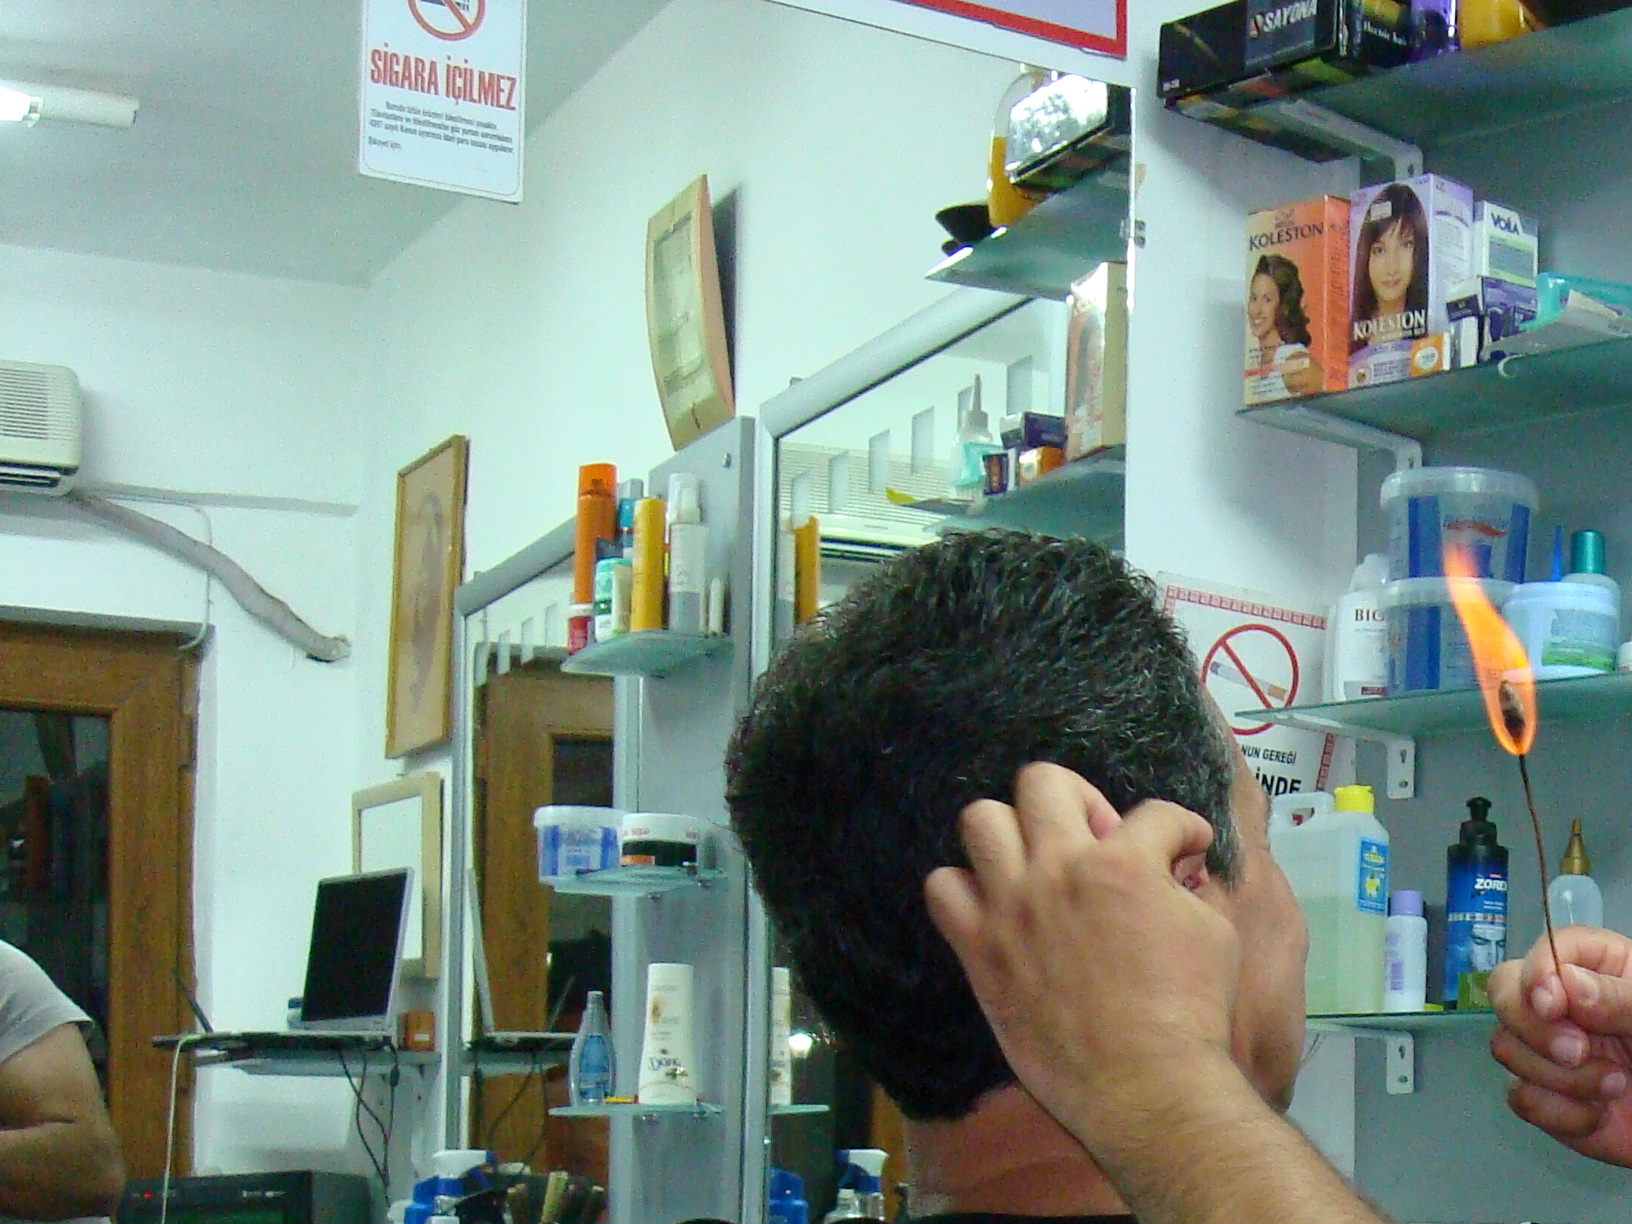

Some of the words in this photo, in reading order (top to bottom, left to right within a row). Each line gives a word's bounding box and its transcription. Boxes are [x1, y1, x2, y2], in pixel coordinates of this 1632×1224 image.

[370, 42, 440, 96] SİGARA
[445, 55, 517, 111] İÇİLMEZ
[1250, 221, 1325, 251] KOLESTON
[1353, 309, 1426, 342] KOLESTON
